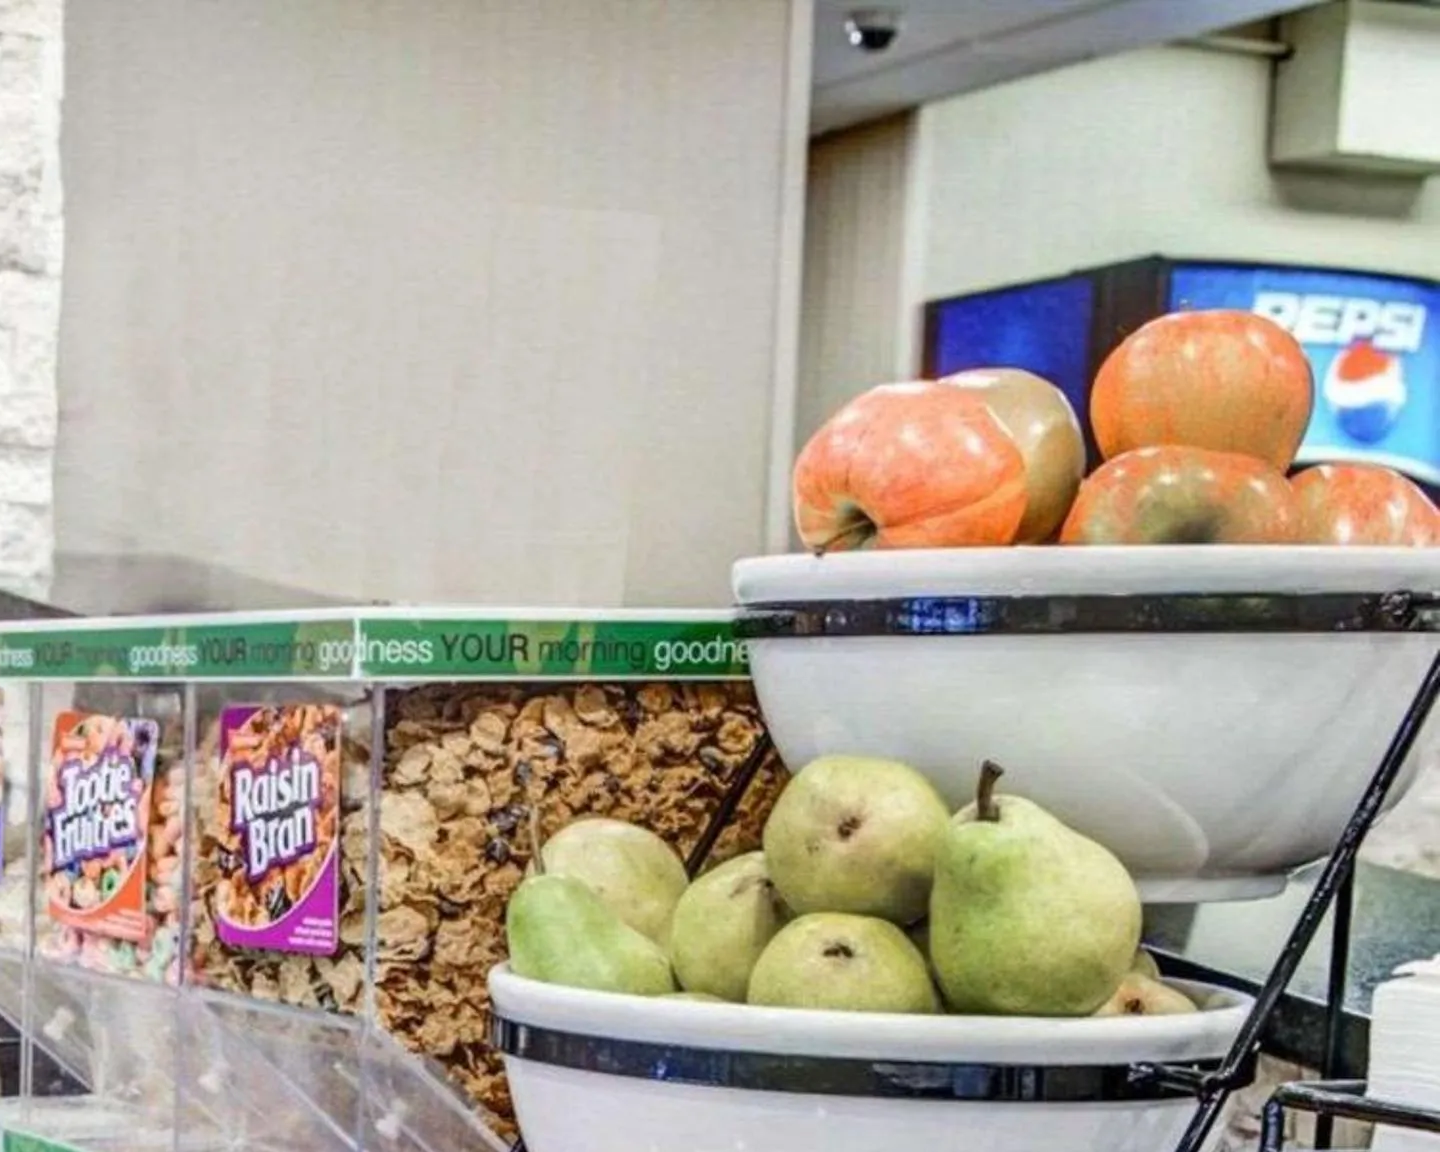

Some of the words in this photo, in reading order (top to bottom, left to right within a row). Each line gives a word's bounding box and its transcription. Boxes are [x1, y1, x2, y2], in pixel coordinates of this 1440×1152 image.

[1252, 292, 1427, 353] PEPSI
[129, 640, 199, 673] goodness
[201, 636, 247, 667] YOUR
[441, 633, 529, 663] YOUR
[538, 635, 647, 669] morning
[62, 756, 131, 813] Tootie
[234, 747, 319, 826] Raisin
[249, 807, 314, 877] Bran
